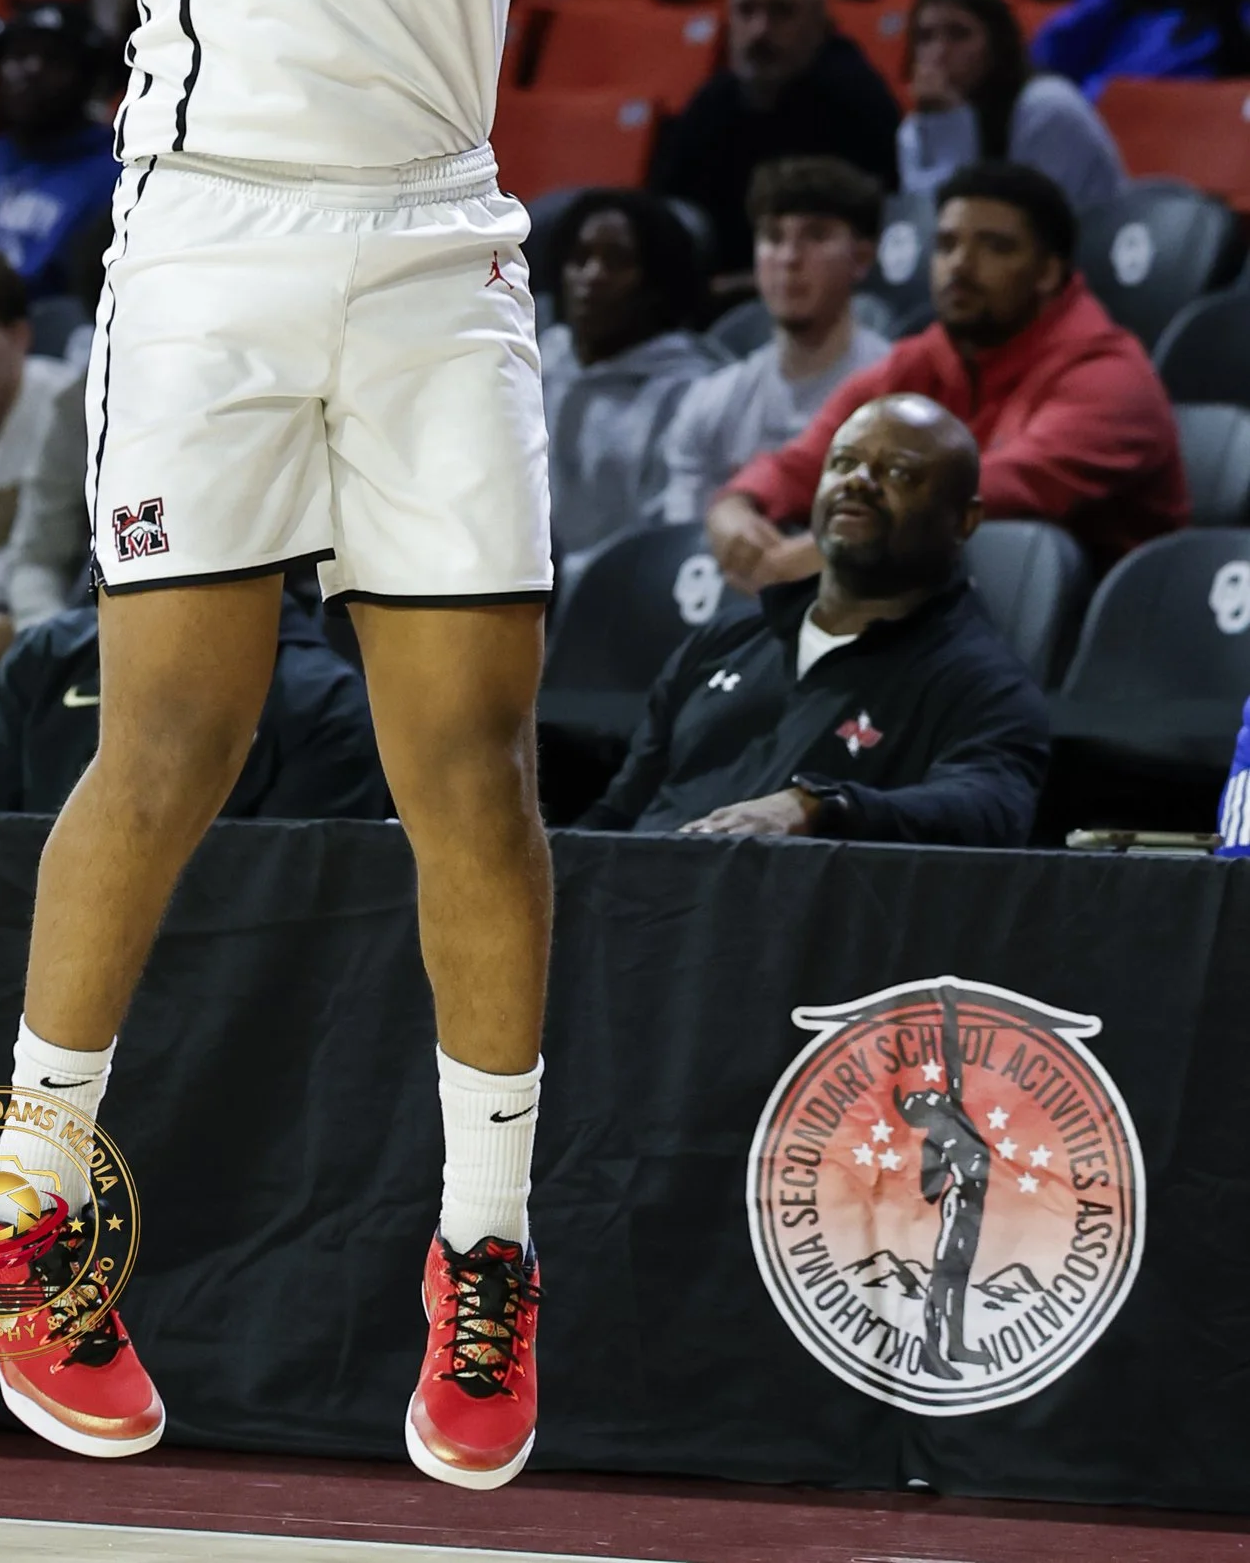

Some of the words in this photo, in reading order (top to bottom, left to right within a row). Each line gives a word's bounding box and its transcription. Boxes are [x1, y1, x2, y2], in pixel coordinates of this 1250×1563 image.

[112, 497, 170, 562] M
[875, 1024, 996, 1075] SCHOL
[1001, 1043, 1110, 1191] ACTIVITIES
[779, 1048, 876, 1228] SECONDARY
[788, 1232, 924, 1376] OKLAHOMA
[978, 1199, 1114, 1375] ASSOCIATION
